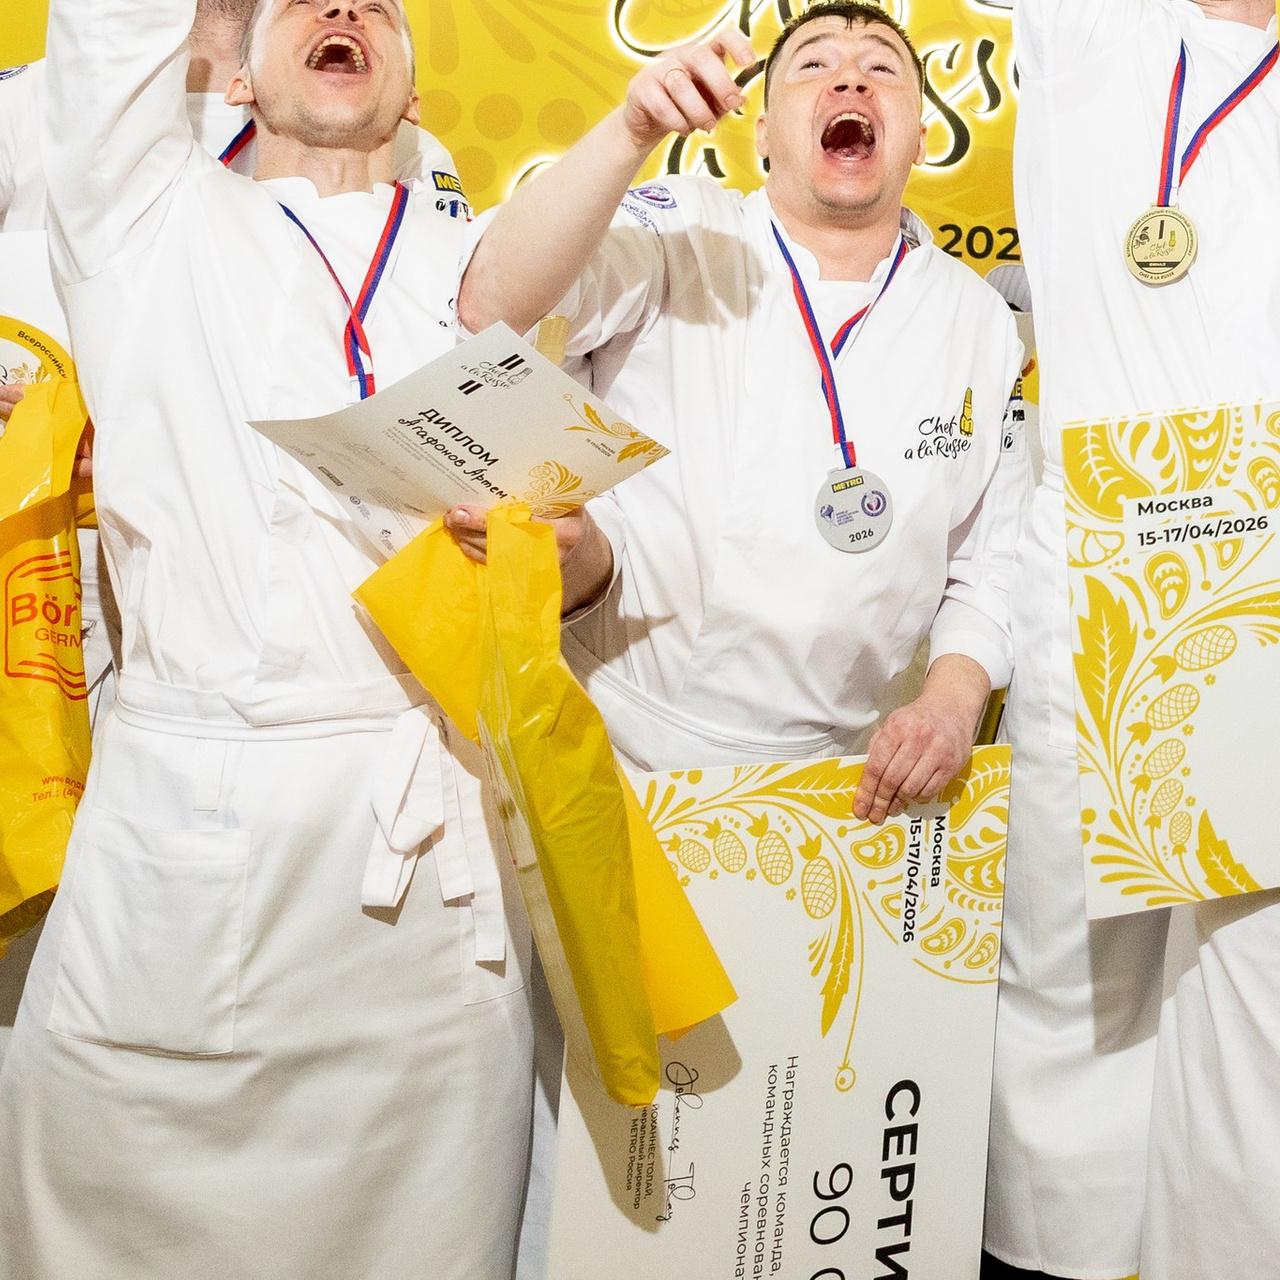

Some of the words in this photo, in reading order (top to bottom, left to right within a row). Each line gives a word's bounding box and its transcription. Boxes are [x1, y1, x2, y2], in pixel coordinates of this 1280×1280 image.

[938, 223, 1020, 262] 202
[418, 408, 499, 466] ДИПЛОМ
[904, 448, 913, 460] a
[917, 439, 934, 459] la
[933, 435, 972, 460] Russe
[918, 415, 958, 437] Chef
[397, 418, 467, 468] Агафонов
[463, 468, 508, 500] Артем
[833, 476, 863, 492] METRO
[1136, 493, 1214, 517] Москва
[848, 527, 875, 543] 2026
[1137, 515, 1269, 548] 15-17/04/2026
[930, 815, 947, 888] Москва
[902, 816, 923, 943] 15-17/04/2026
[629, 1117, 638, 1155] METRO
[761, 1064, 778, 1170] командных
[777, 1055, 799, 1187] Награждается
[625, 1155, 635, 1191] Россия
[633, 1161, 644, 1210] директор
[873, 1079, 921, 1280] СЕРТИ
[809, 1162, 854, 1246] 90
[769, 1191, 787, 1277] команда,
